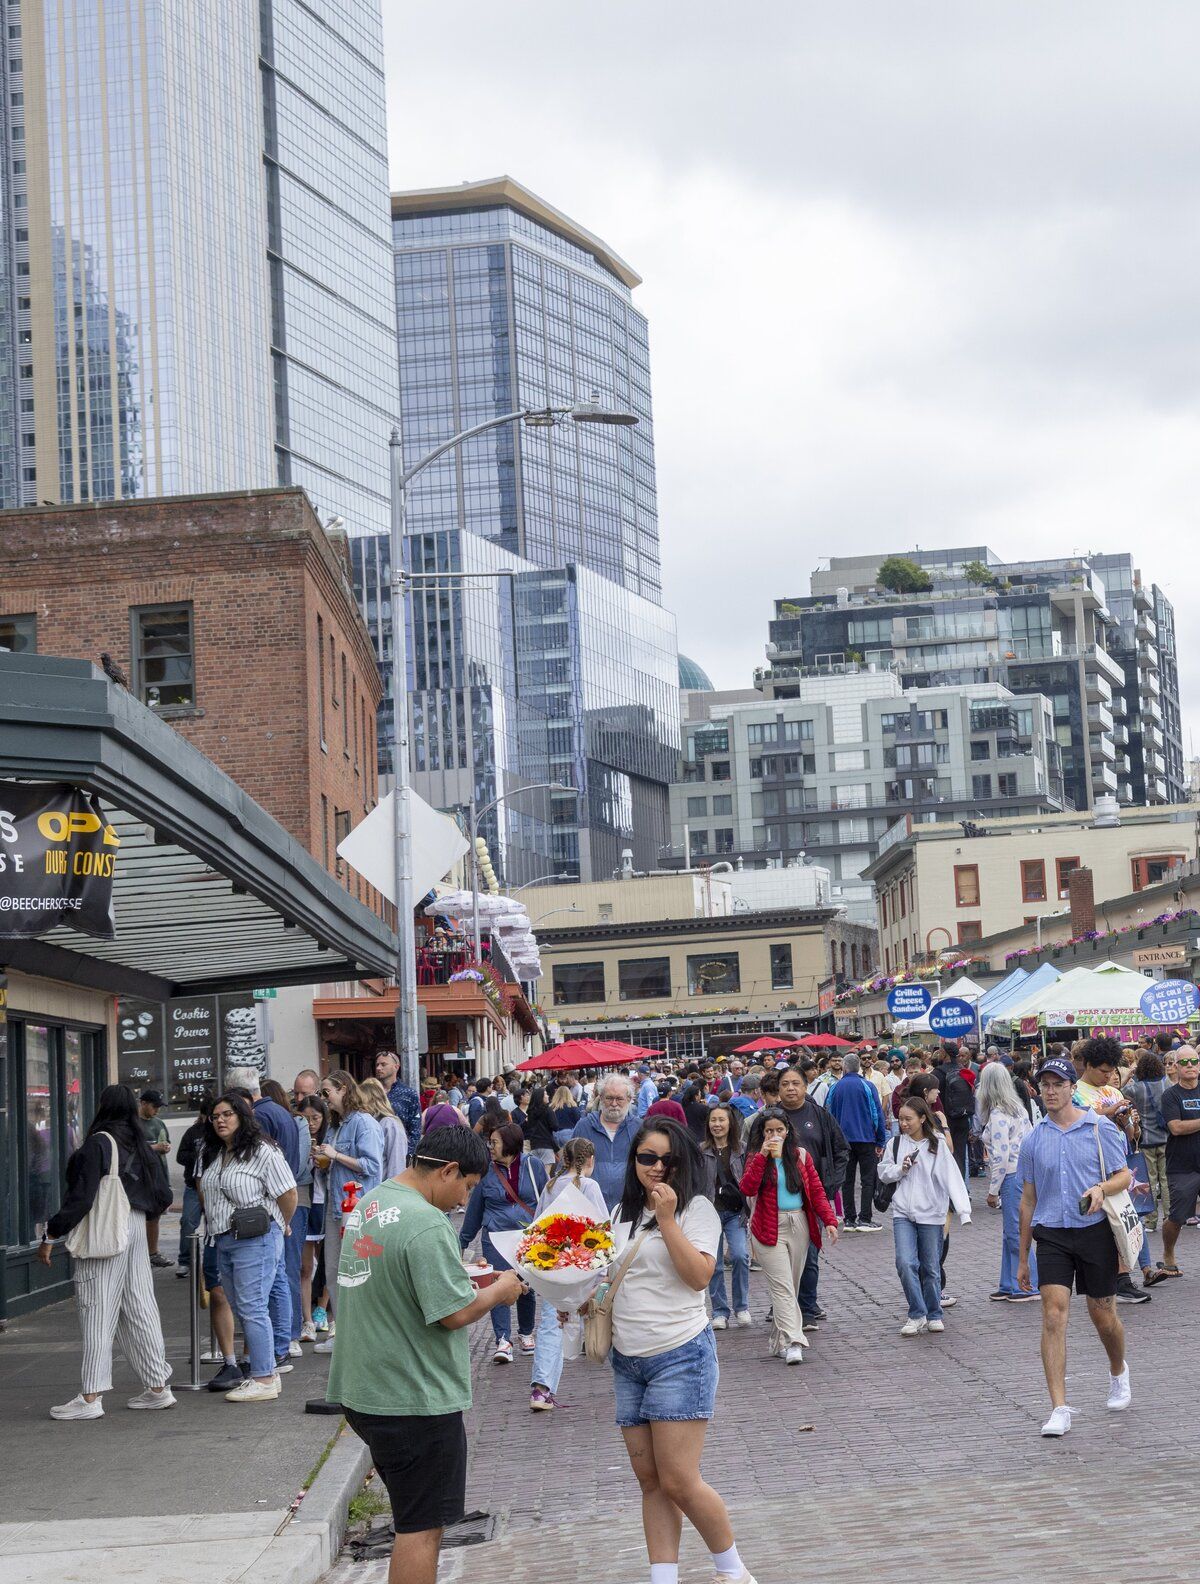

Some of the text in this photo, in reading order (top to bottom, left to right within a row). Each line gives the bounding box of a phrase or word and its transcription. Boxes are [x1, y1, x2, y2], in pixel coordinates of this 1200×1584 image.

[1138, 951, 1182, 962] ENTRANCE
[1154, 980, 1182, 991] ORGANIC
[1155, 987, 1182, 999] ICE COLD
[894, 997, 924, 1005] Cheese
[1150, 995, 1195, 1013] APPLE
[172, 1007, 210, 1021] Cookie
[891, 1004, 927, 1013] Sandwich
[941, 1006, 961, 1016] Ice
[1150, 1004, 1196, 1021] CIDER
[931, 1015, 973, 1028] Cream
[173, 1025, 210, 1039] Power
[174, 1057, 212, 1067] BAKERY
[130, 1067, 149, 1078] Tea
[178, 1070, 208, 1080] SINCE
[182, 1085, 205, 1095] 1985
